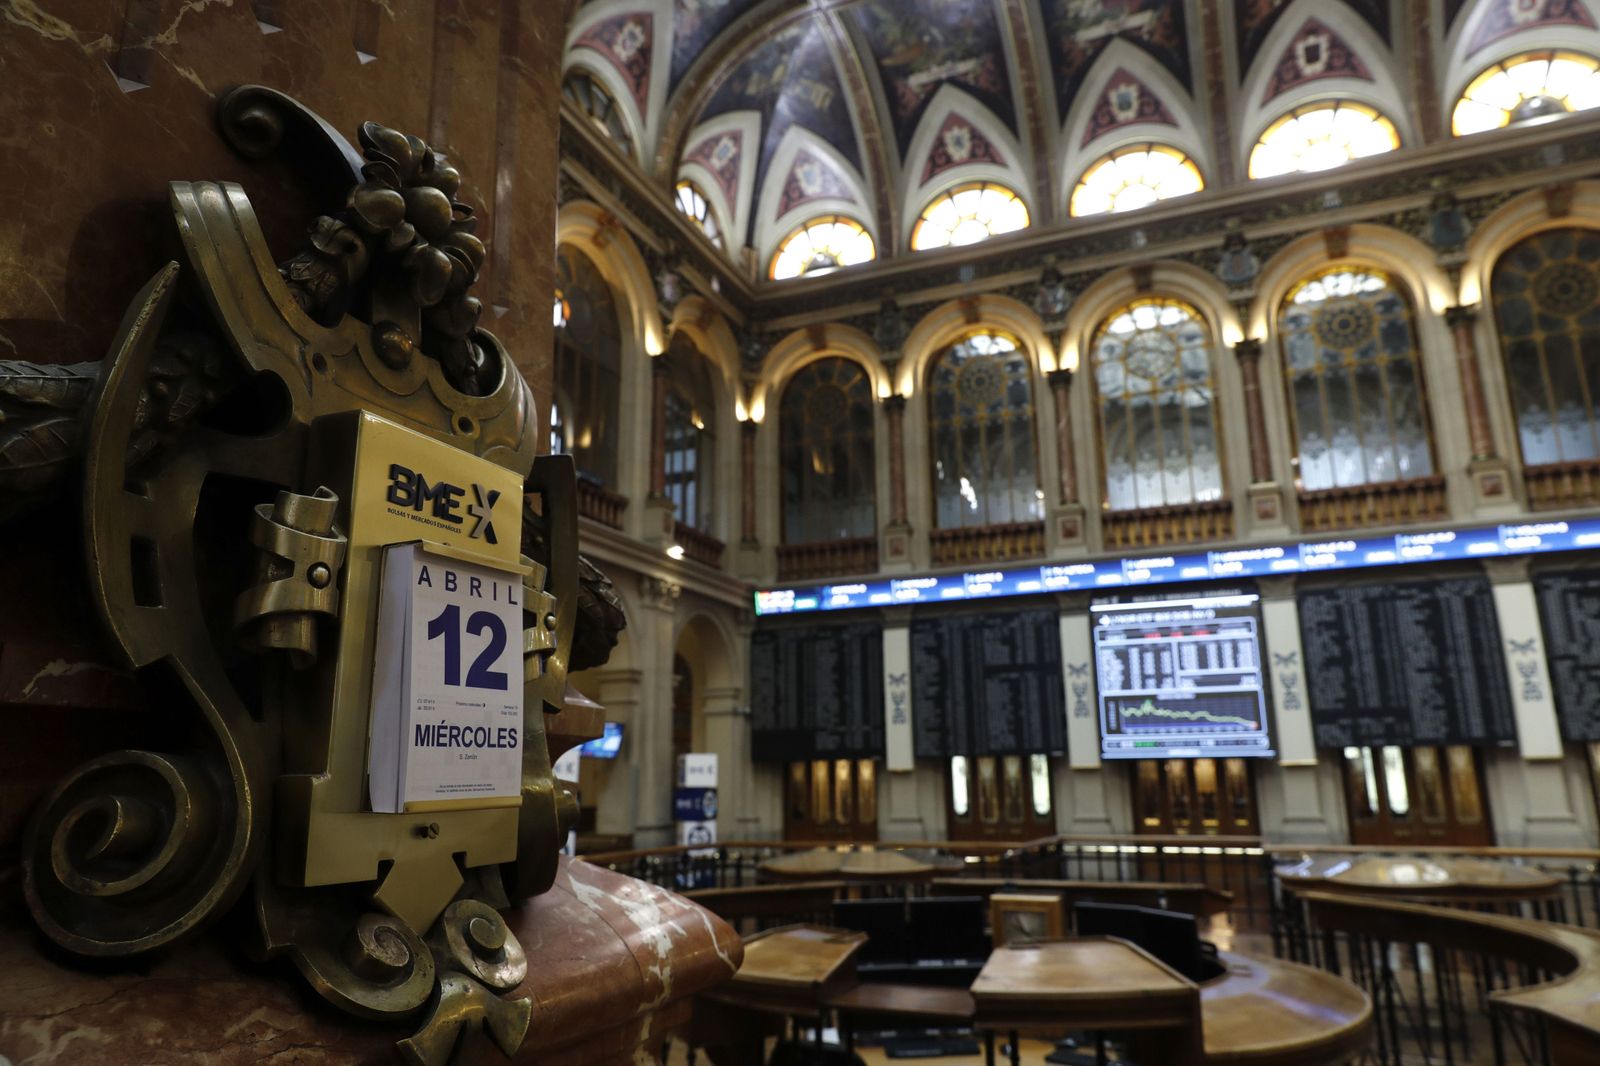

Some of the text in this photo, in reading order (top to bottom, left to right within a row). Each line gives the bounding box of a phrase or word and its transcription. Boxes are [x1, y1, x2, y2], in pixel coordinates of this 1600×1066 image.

[387, 464, 465, 524] BME
[387, 507, 405, 518] BOLSAS
[411, 515, 436, 527] MERCADOS
[437, 521, 461, 534] ESPAÑOLES
[417, 565, 518, 605] ABRIL
[428, 603, 508, 691] 12
[415, 720, 518, 749] MIÉRCOLES
